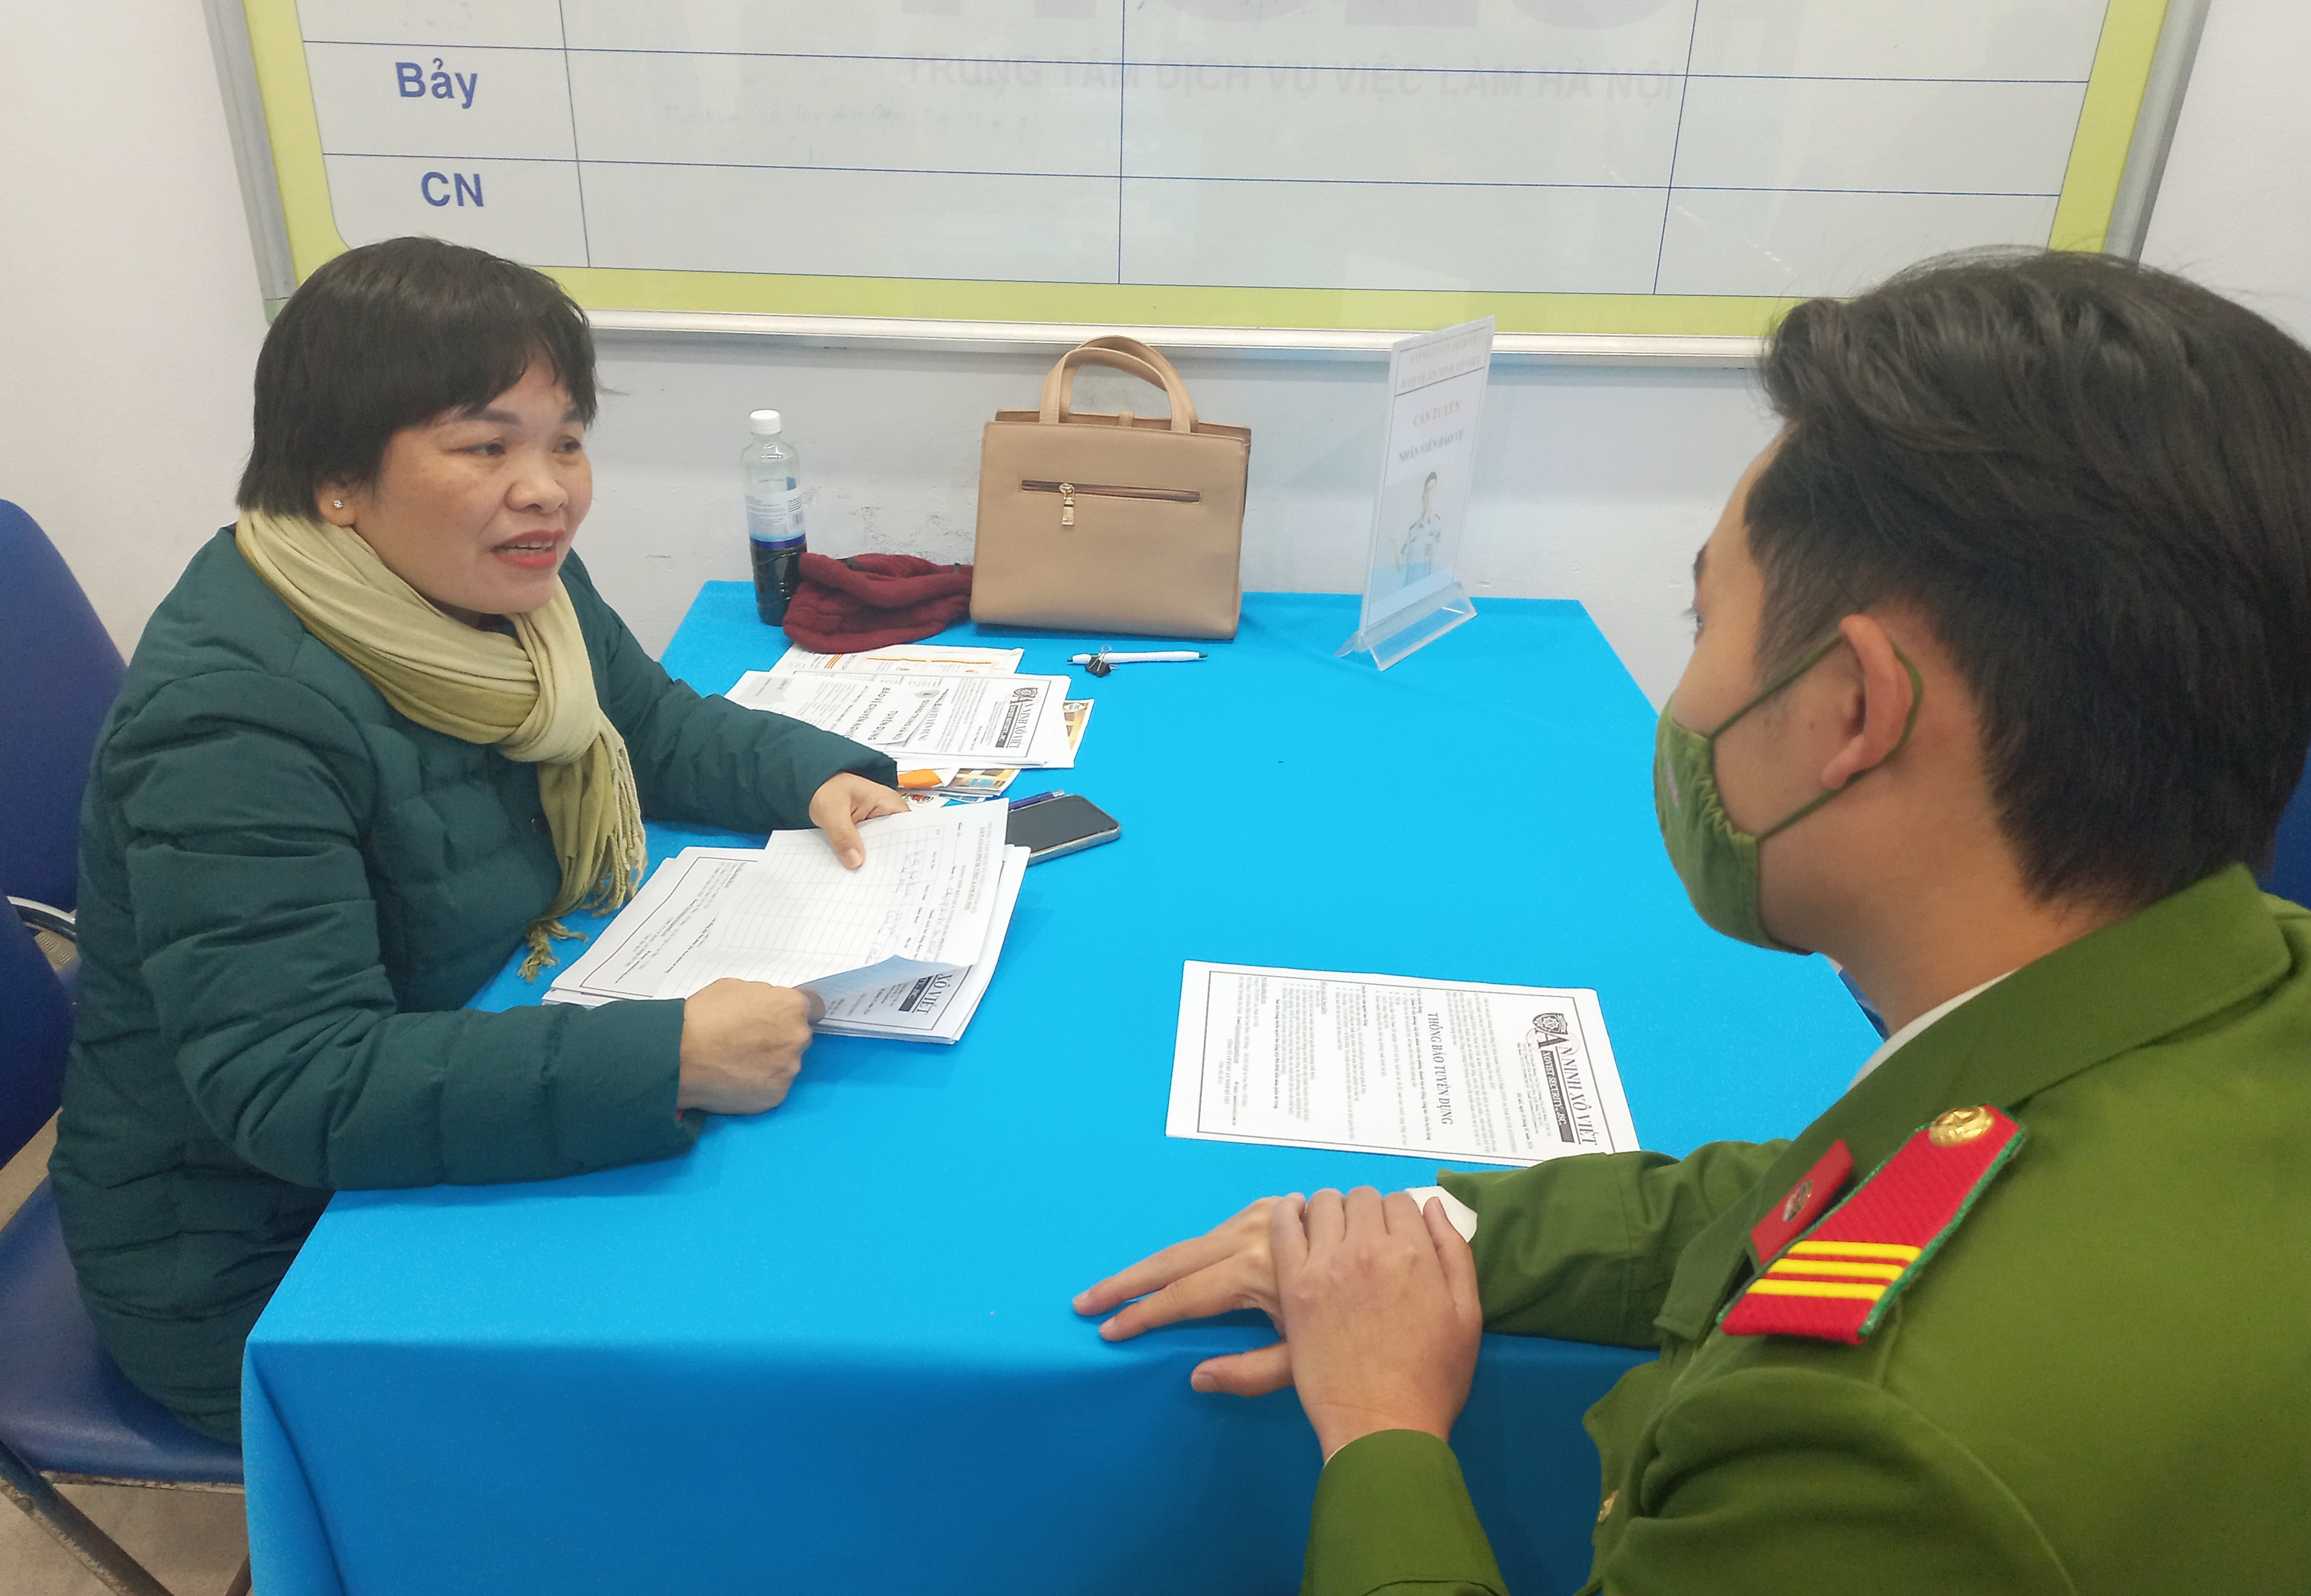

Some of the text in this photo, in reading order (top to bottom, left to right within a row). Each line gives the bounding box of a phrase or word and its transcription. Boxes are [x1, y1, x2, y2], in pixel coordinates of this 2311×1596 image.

[395, 57, 478, 109] Bảy
[421, 172, 484, 207] CN
[1561, 1058, 1582, 1090] NINH
[1435, 1097, 1453, 1125] DỤNG
[1570, 1093, 1592, 1111] XÔ
[1576, 1114, 1600, 1146] VIẾT
